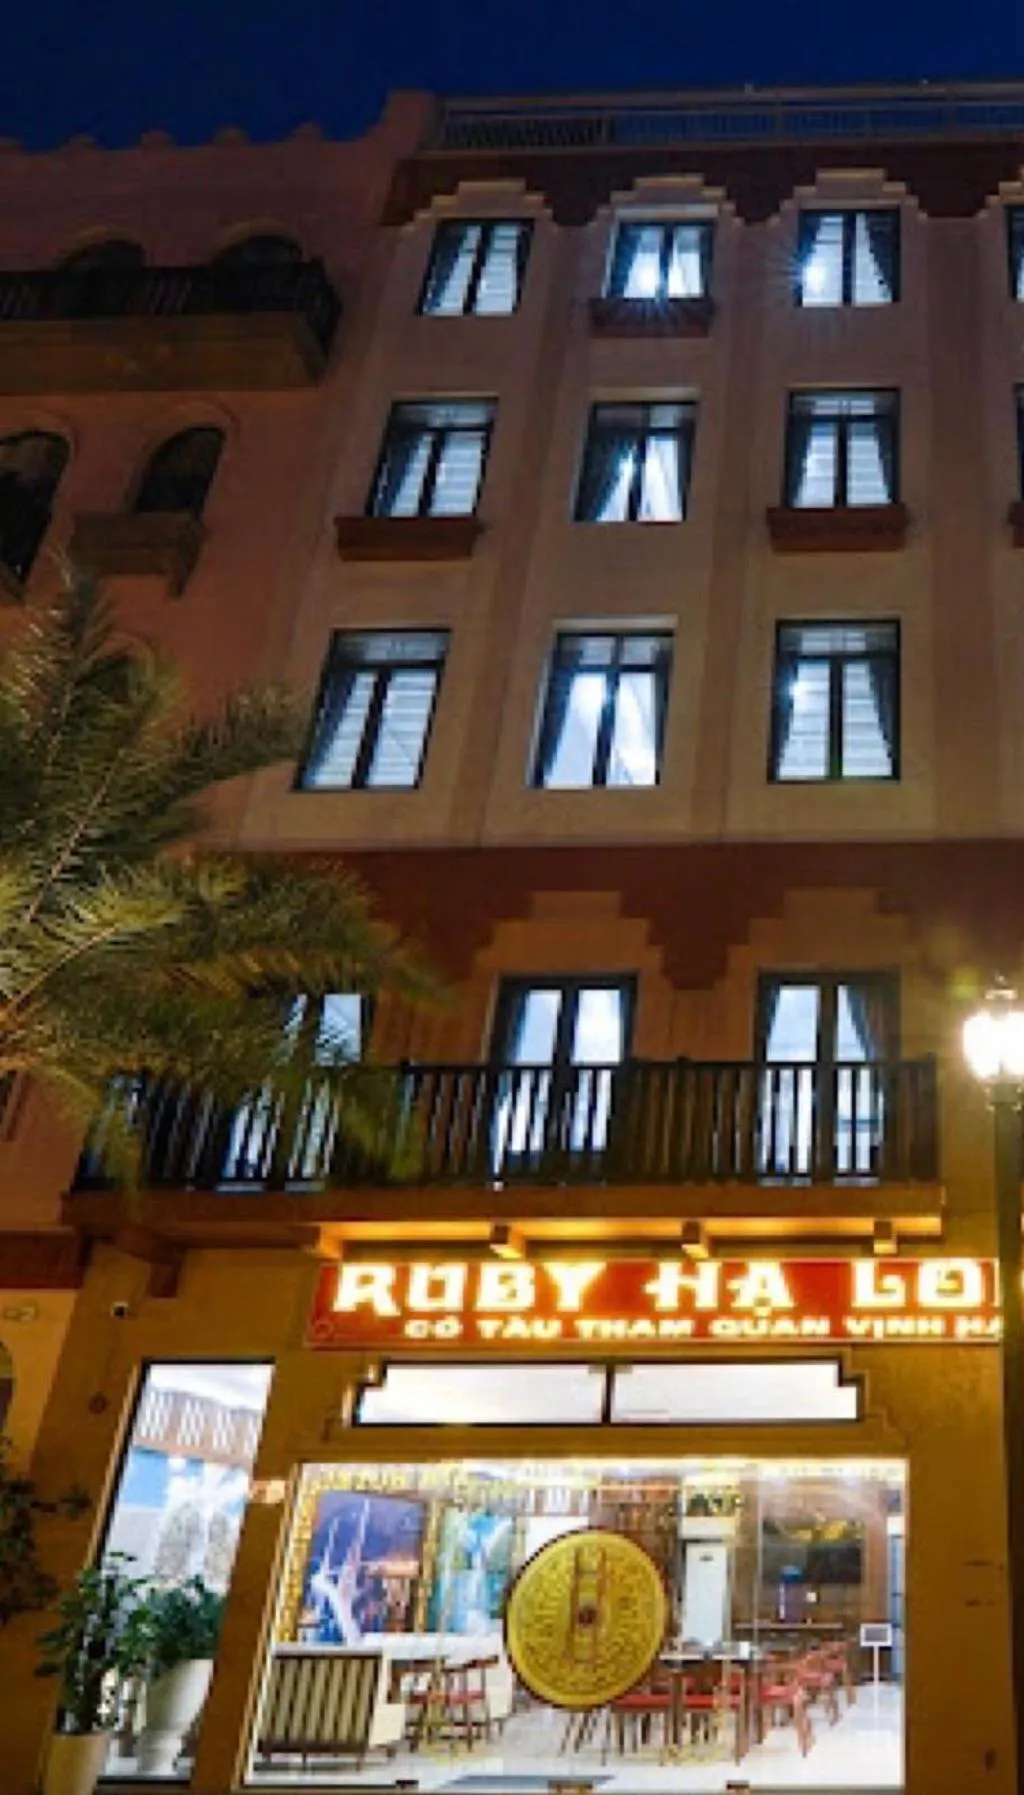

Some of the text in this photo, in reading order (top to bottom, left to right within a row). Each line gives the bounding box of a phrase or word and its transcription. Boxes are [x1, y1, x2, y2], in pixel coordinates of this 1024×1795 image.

[333, 1262, 606, 1316] RUBY
[644, 1261, 796, 1318] HẠ
[575, 1318, 694, 1340] THAM
[709, 1315, 831, 1338] QUAN
